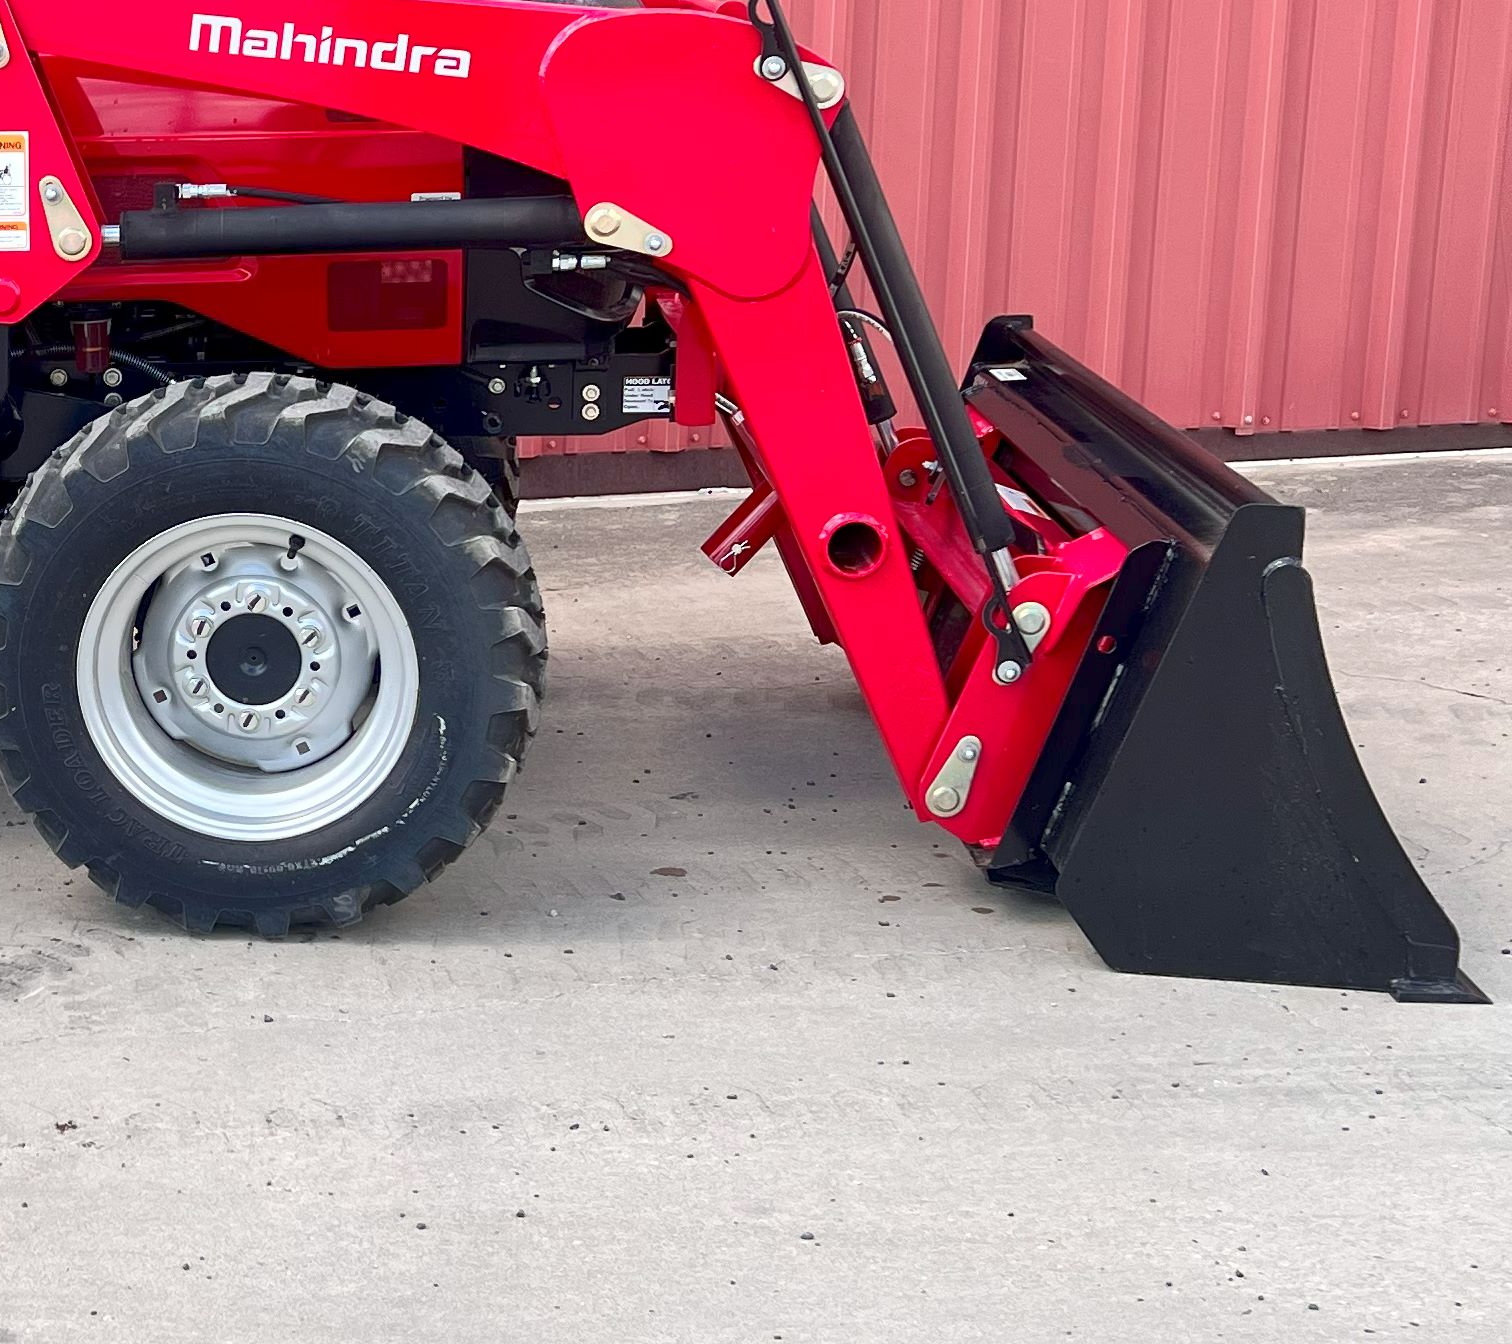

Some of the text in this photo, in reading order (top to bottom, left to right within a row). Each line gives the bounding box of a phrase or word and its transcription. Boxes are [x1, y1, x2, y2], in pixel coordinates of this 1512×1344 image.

[188, 13, 472, 79] Mahindra
[345, 512, 442, 631] TITAN
[41, 682, 189, 863] TRAC LOADER
